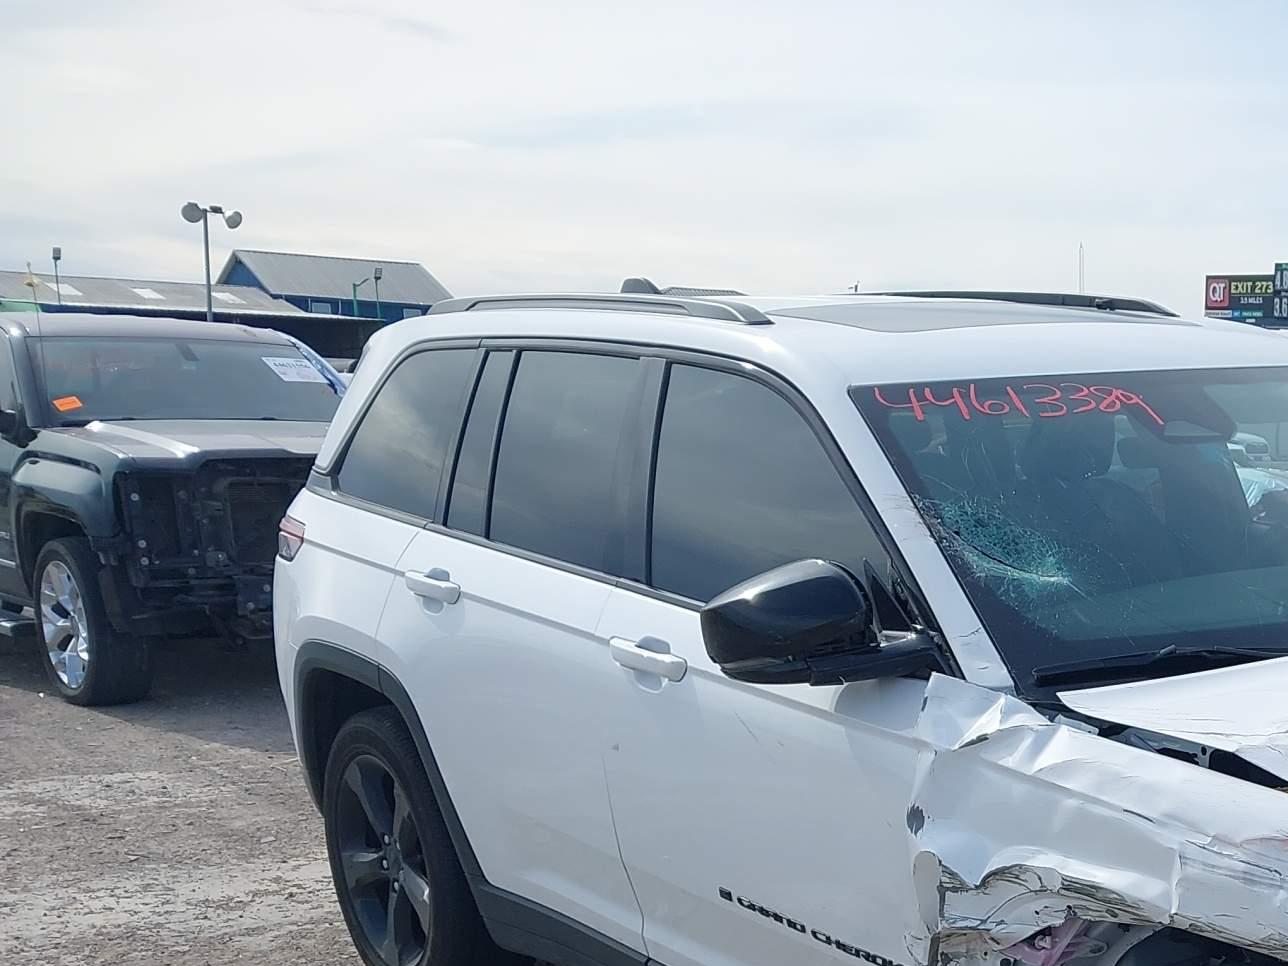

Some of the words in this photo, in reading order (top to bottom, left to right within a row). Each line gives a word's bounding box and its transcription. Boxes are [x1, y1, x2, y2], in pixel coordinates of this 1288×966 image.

[1210, 283, 1226, 302] QT
[1231, 281, 1253, 293] EXIT
[1255, 281, 1274, 293] 273
[874, 384, 1165, 424] 44613389
